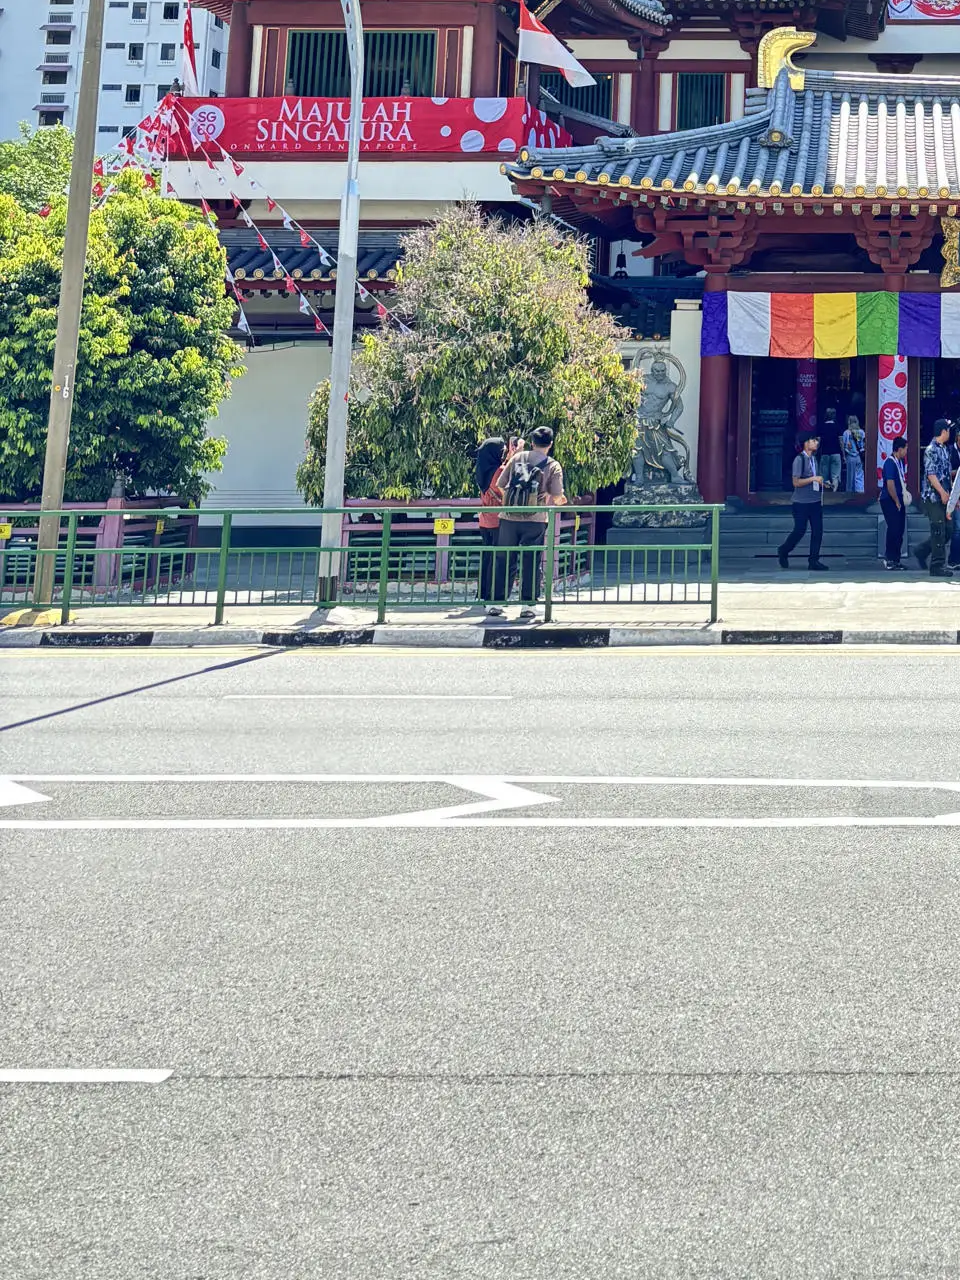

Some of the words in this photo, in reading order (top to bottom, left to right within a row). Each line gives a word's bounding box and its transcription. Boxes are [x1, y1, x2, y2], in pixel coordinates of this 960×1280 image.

[198, 111, 217, 122] SG
[278, 98, 413, 126] MAJULAH
[883, 408, 902, 420] SG
[883, 421, 902, 434] 60
